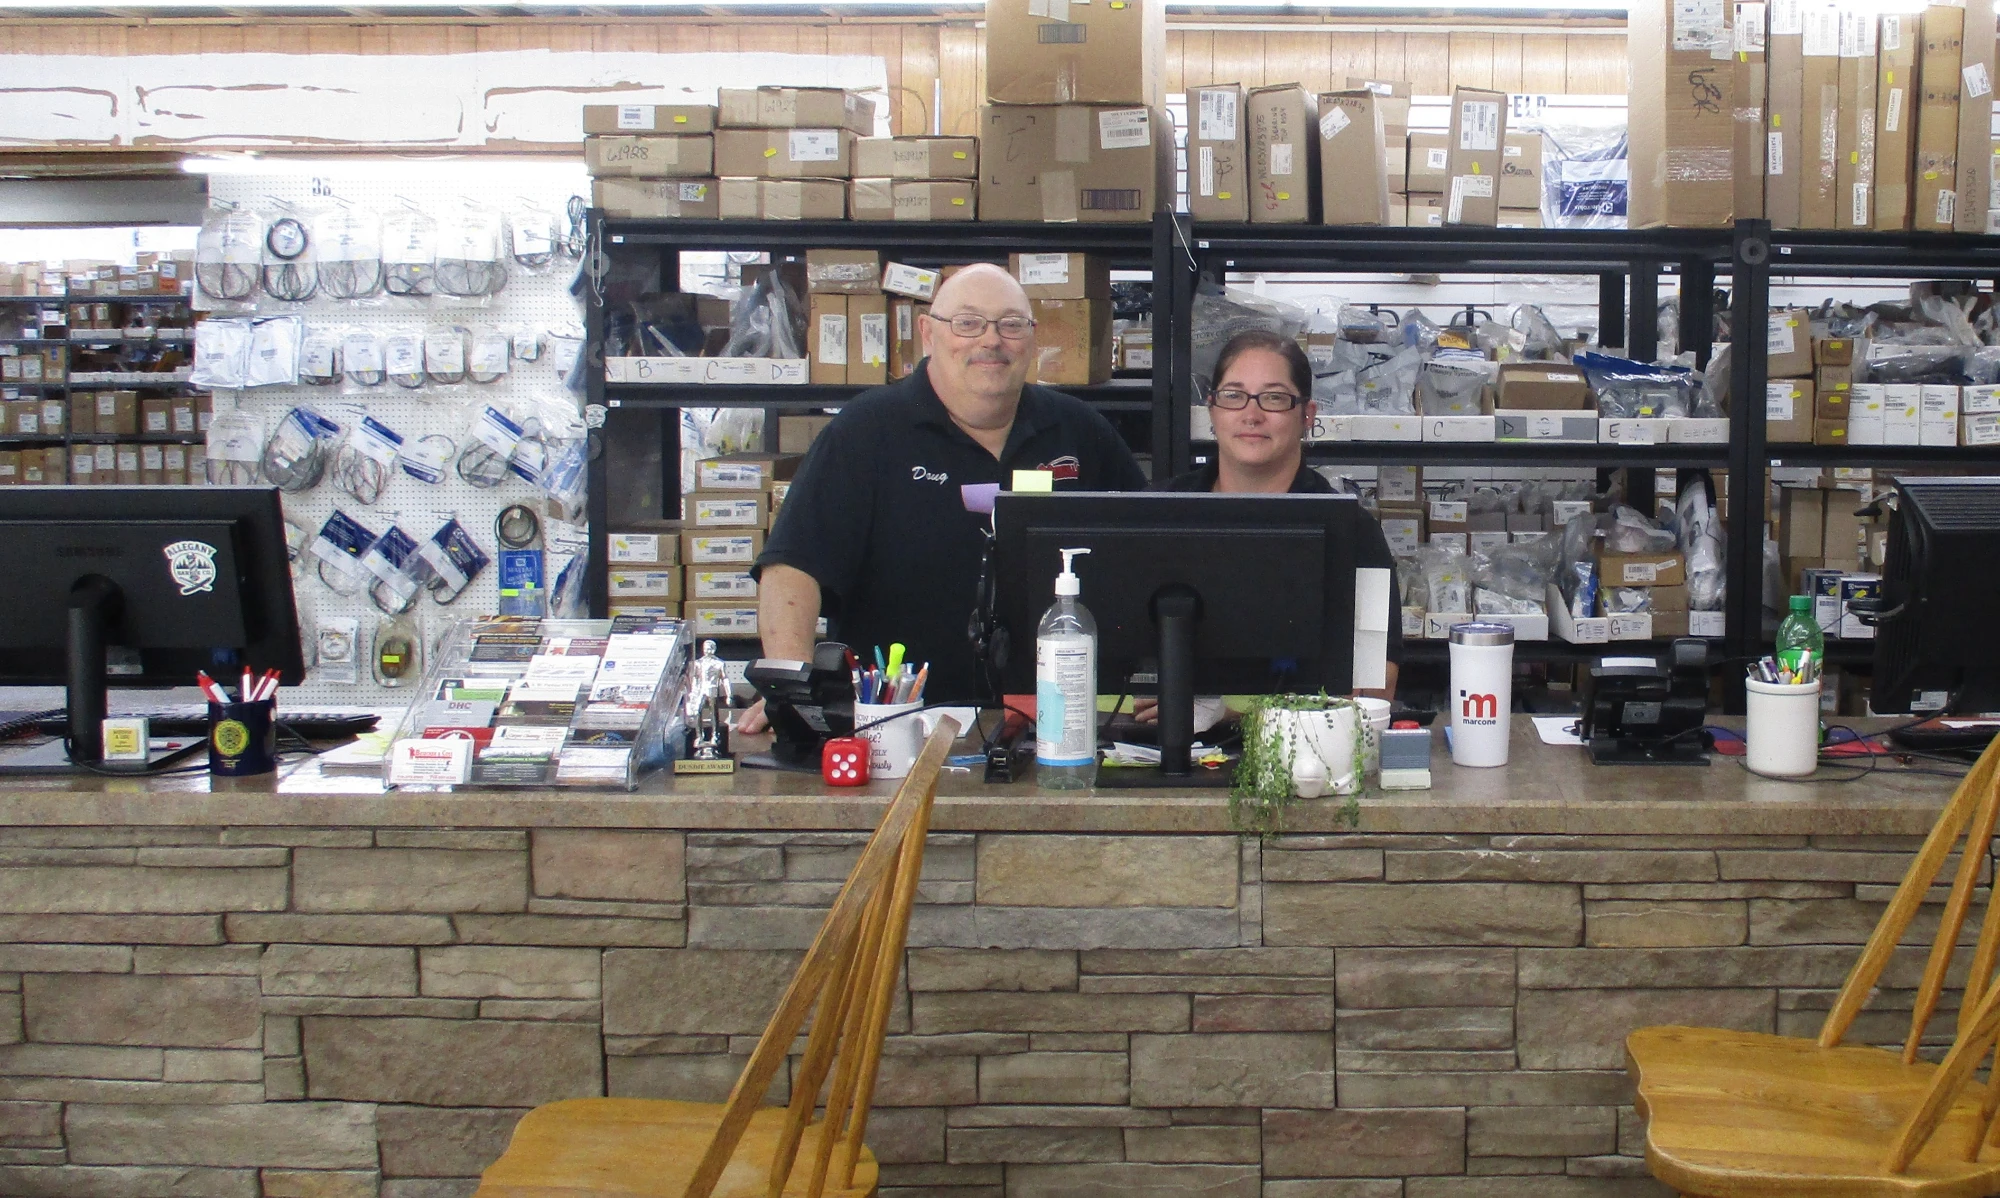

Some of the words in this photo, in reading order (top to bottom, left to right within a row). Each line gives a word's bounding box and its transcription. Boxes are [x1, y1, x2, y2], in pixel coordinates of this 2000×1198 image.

[607, 145, 649, 161] 61928
[635, 359, 652, 378] B
[706, 361, 719, 380] C
[772, 364, 783, 380] D
[1434, 421, 1444, 438] C
[1609, 423, 1620, 438] E
[911, 466, 949, 485] Doug
[166, 543, 213, 557] ALLEGANY
[1430, 619, 1441, 633] D
[1576, 623, 1584, 637] F
[1610, 619, 1620, 636] G
